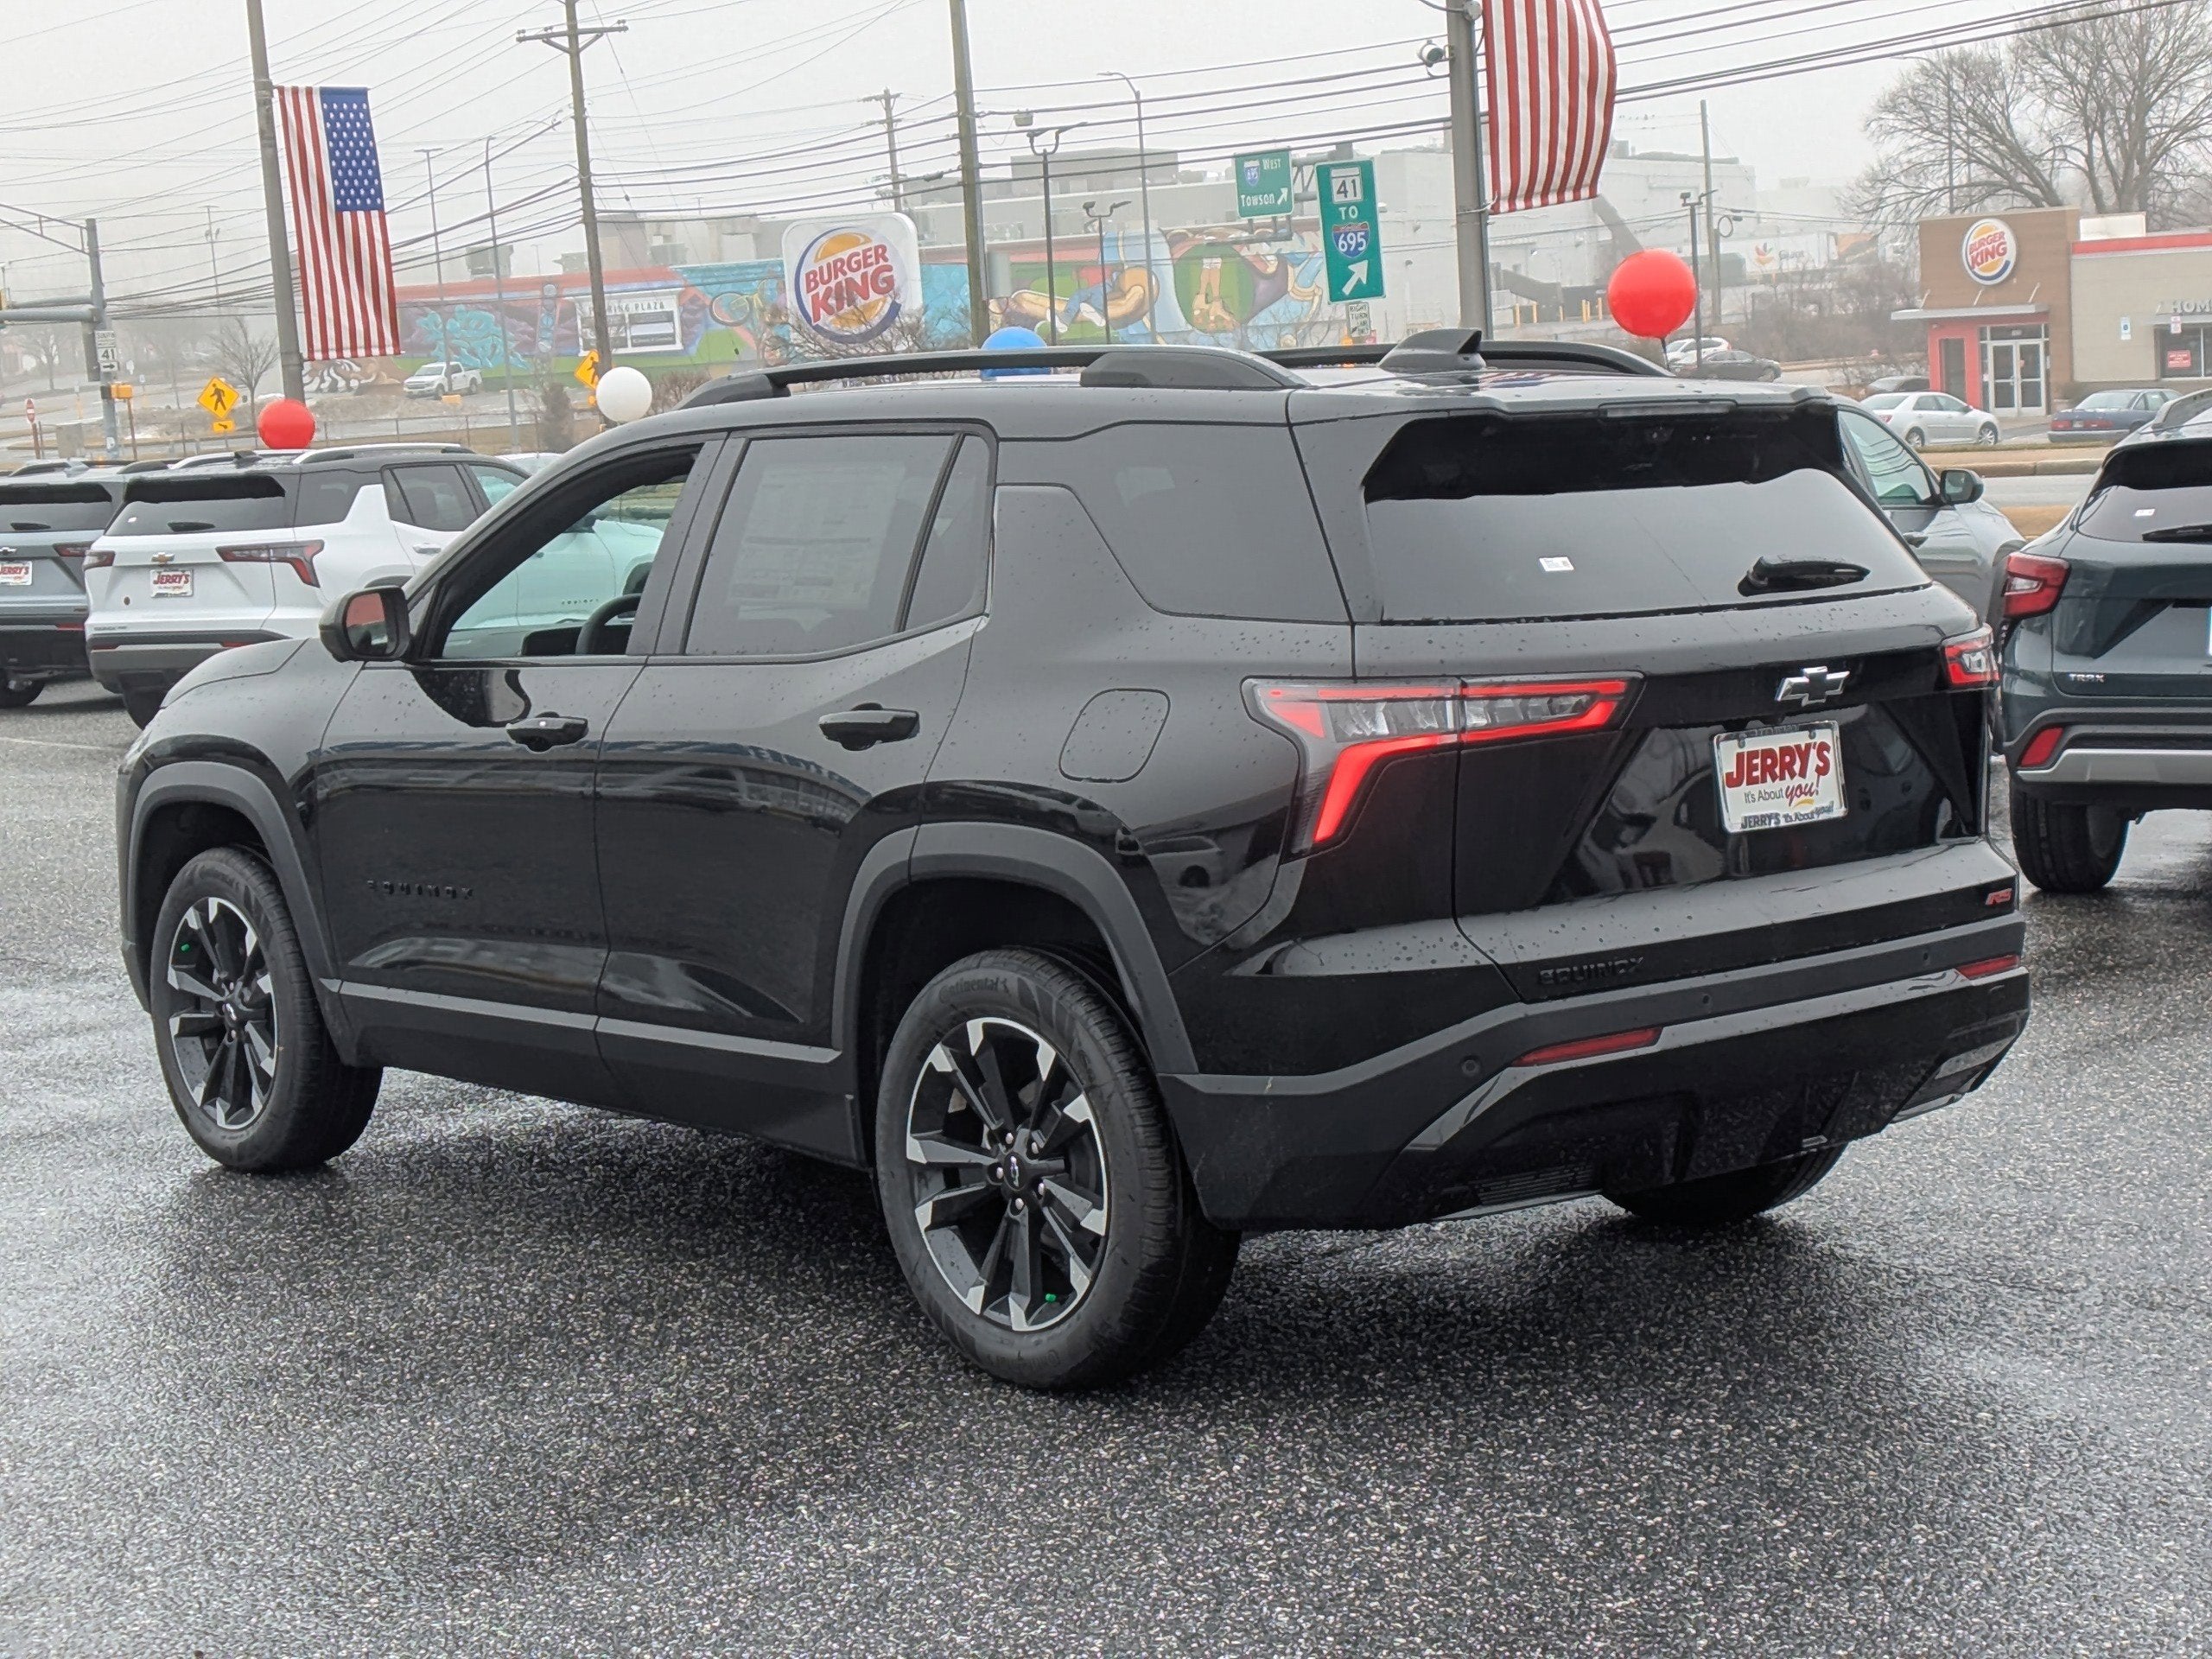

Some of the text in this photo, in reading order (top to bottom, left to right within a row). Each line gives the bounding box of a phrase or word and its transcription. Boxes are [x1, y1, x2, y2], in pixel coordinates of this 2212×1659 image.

[1336, 179, 1357, 199] 41
[1240, 194, 1275, 207] Towson
[1338, 205, 1359, 220] TO
[1338, 232, 1366, 252] 695
[1969, 230, 2005, 256] BURGER
[1971, 241, 2008, 270] KING
[804, 244, 889, 294] BURGER
[810, 264, 895, 323] KING
[634, 301, 665, 311] PLAZA
[101, 348, 115, 360] 41
[2069, 673, 2105, 683] TRAX
[1726, 741, 1832, 789] JERRY'S
[1745, 774, 1821, 807] It's About you!
[1985, 887, 2013, 906] RS
[1539, 956, 1644, 985] EQUINOX
